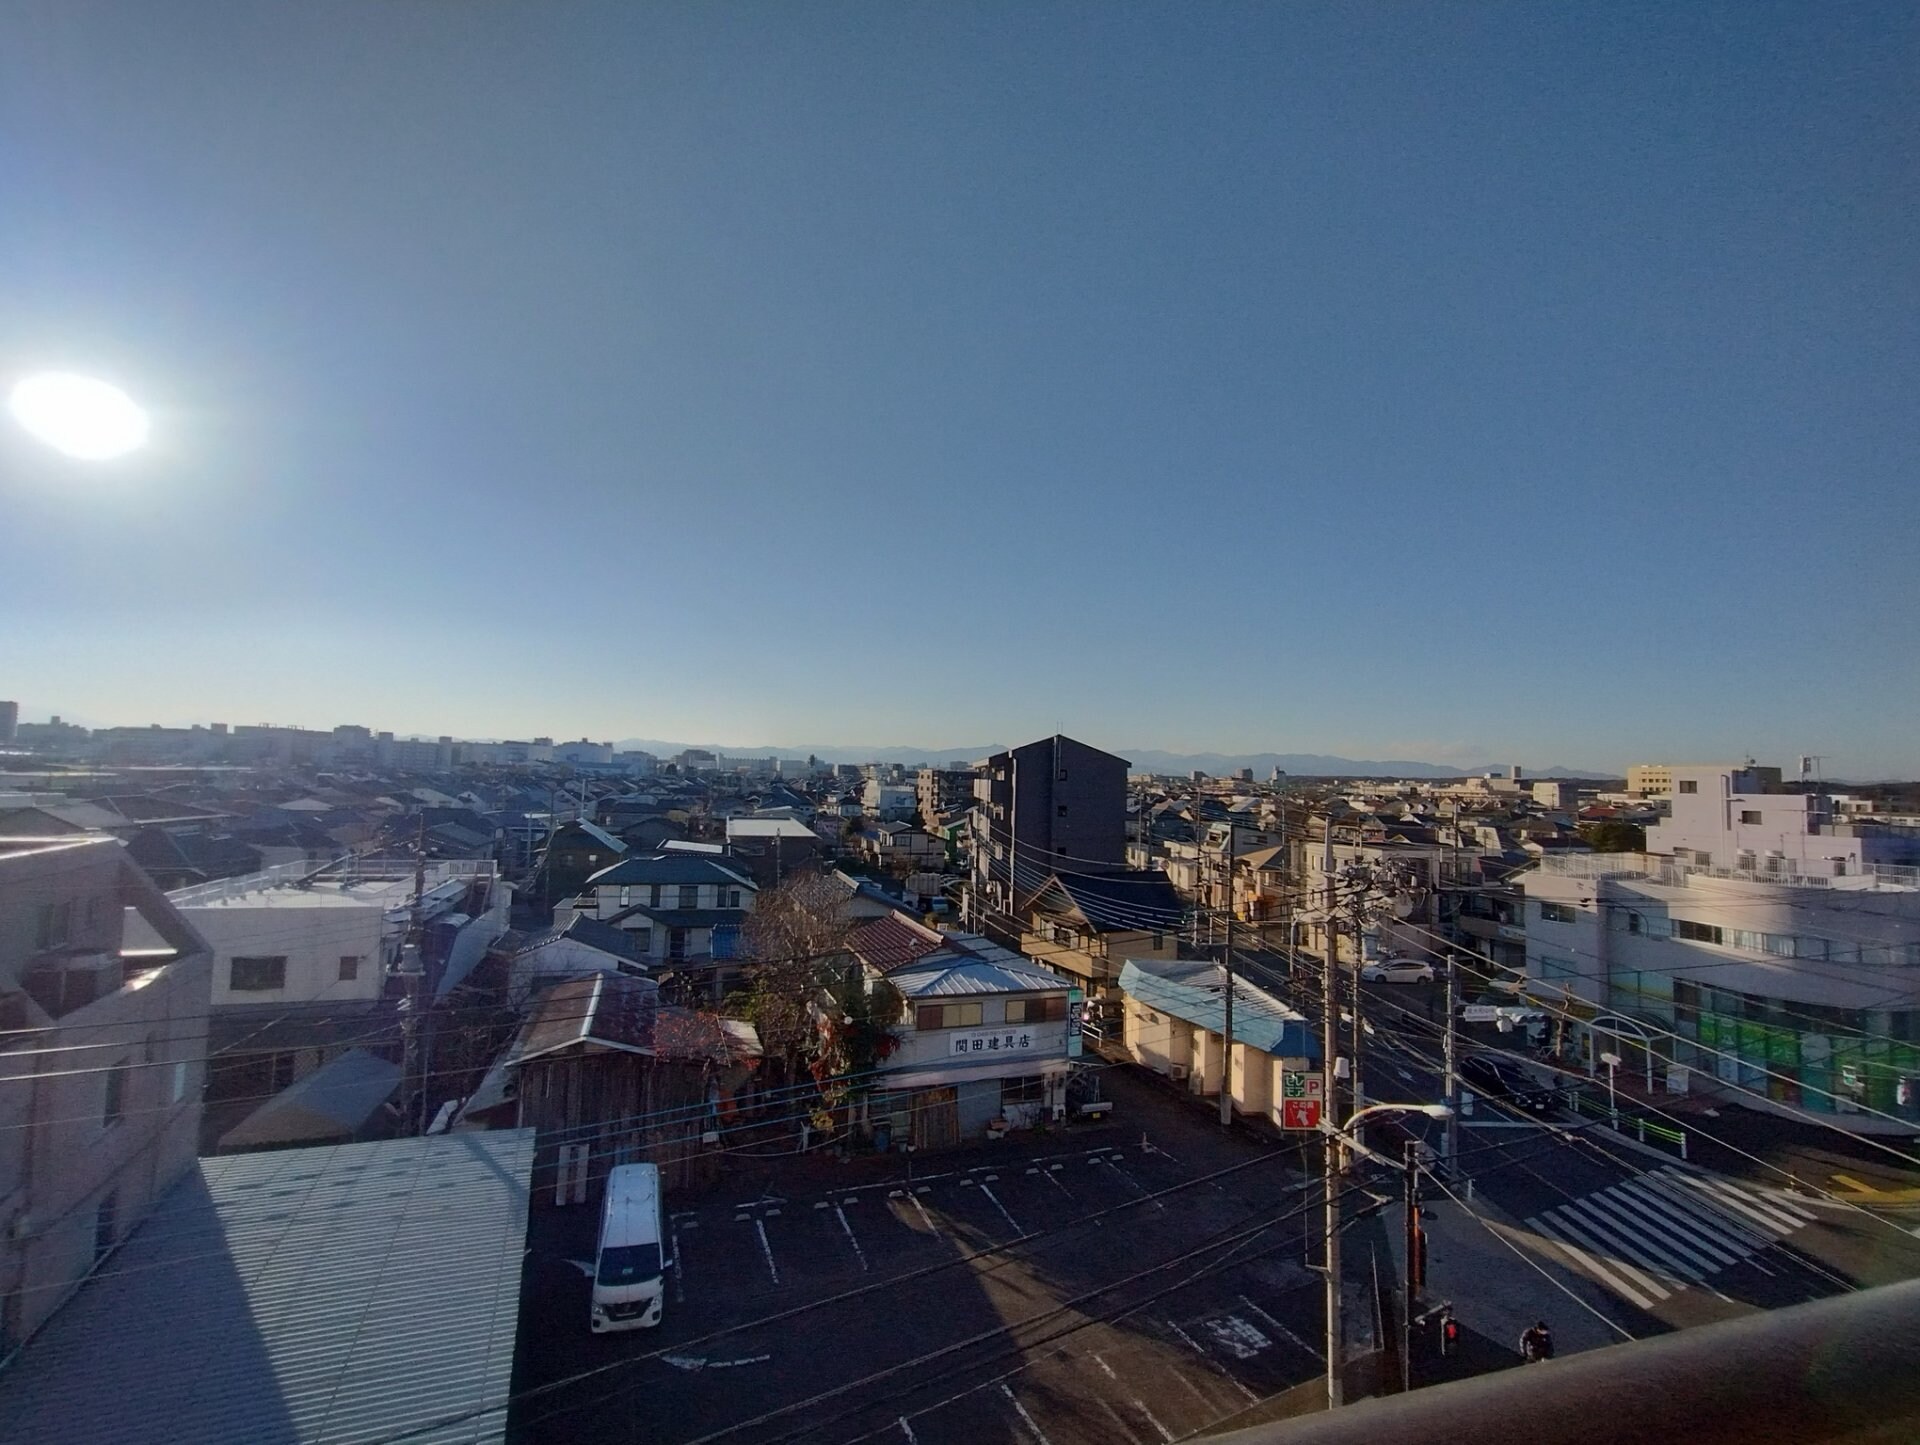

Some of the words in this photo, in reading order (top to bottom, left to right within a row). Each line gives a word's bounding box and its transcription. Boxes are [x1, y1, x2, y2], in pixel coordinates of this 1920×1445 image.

[955, 1033, 1031, 1053] 関田建具店
[1309, 1080, 1319, 1093] P
